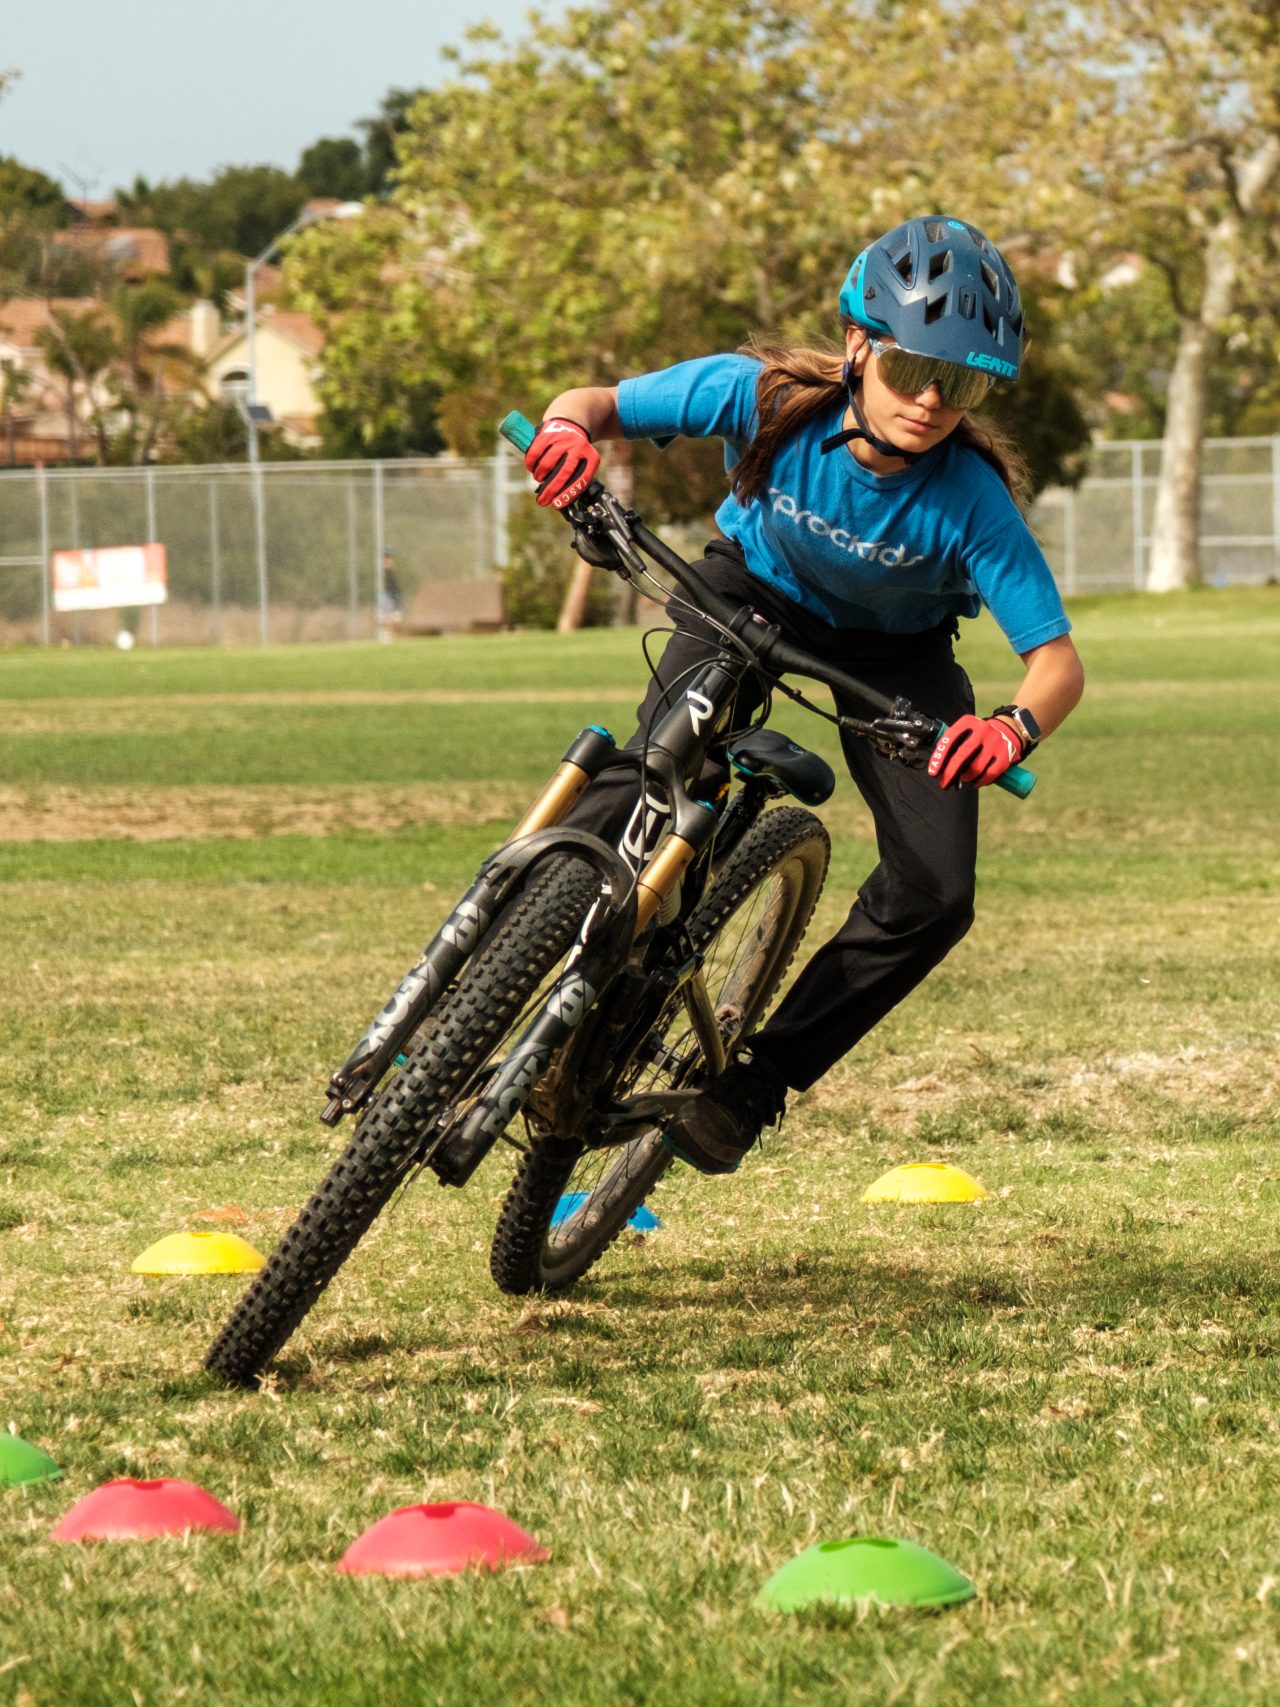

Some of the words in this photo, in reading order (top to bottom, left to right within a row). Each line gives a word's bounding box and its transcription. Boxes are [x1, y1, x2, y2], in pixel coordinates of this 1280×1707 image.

[966, 351, 1018, 377] LEATT
[554, 478, 588, 507] TASCO
[927, 737, 950, 773] TASCO
